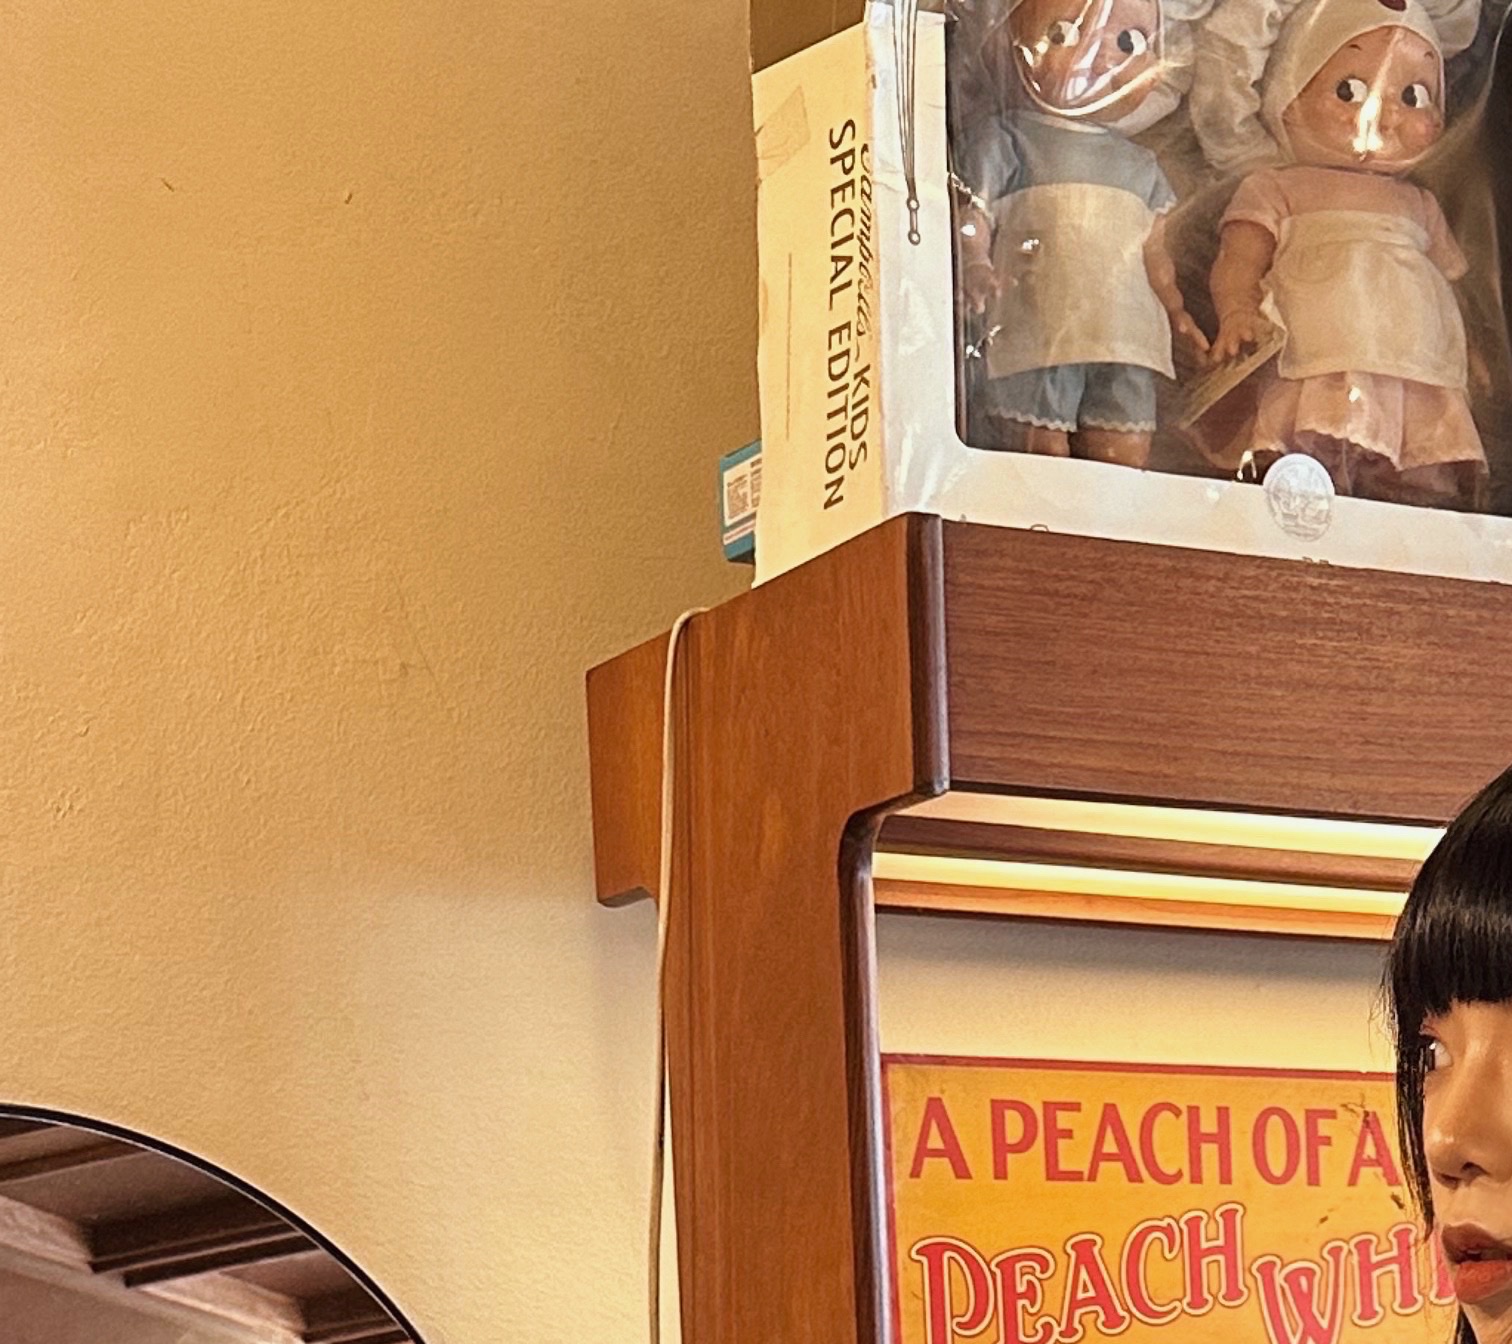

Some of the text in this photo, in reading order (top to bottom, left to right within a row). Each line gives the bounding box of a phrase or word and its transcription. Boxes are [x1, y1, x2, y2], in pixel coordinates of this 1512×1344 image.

[822, 118, 856, 511] SPECIAL EDITION
[848, 363, 871, 472] KIDS
[909, 1096, 1400, 1188] A PEACH OF A
